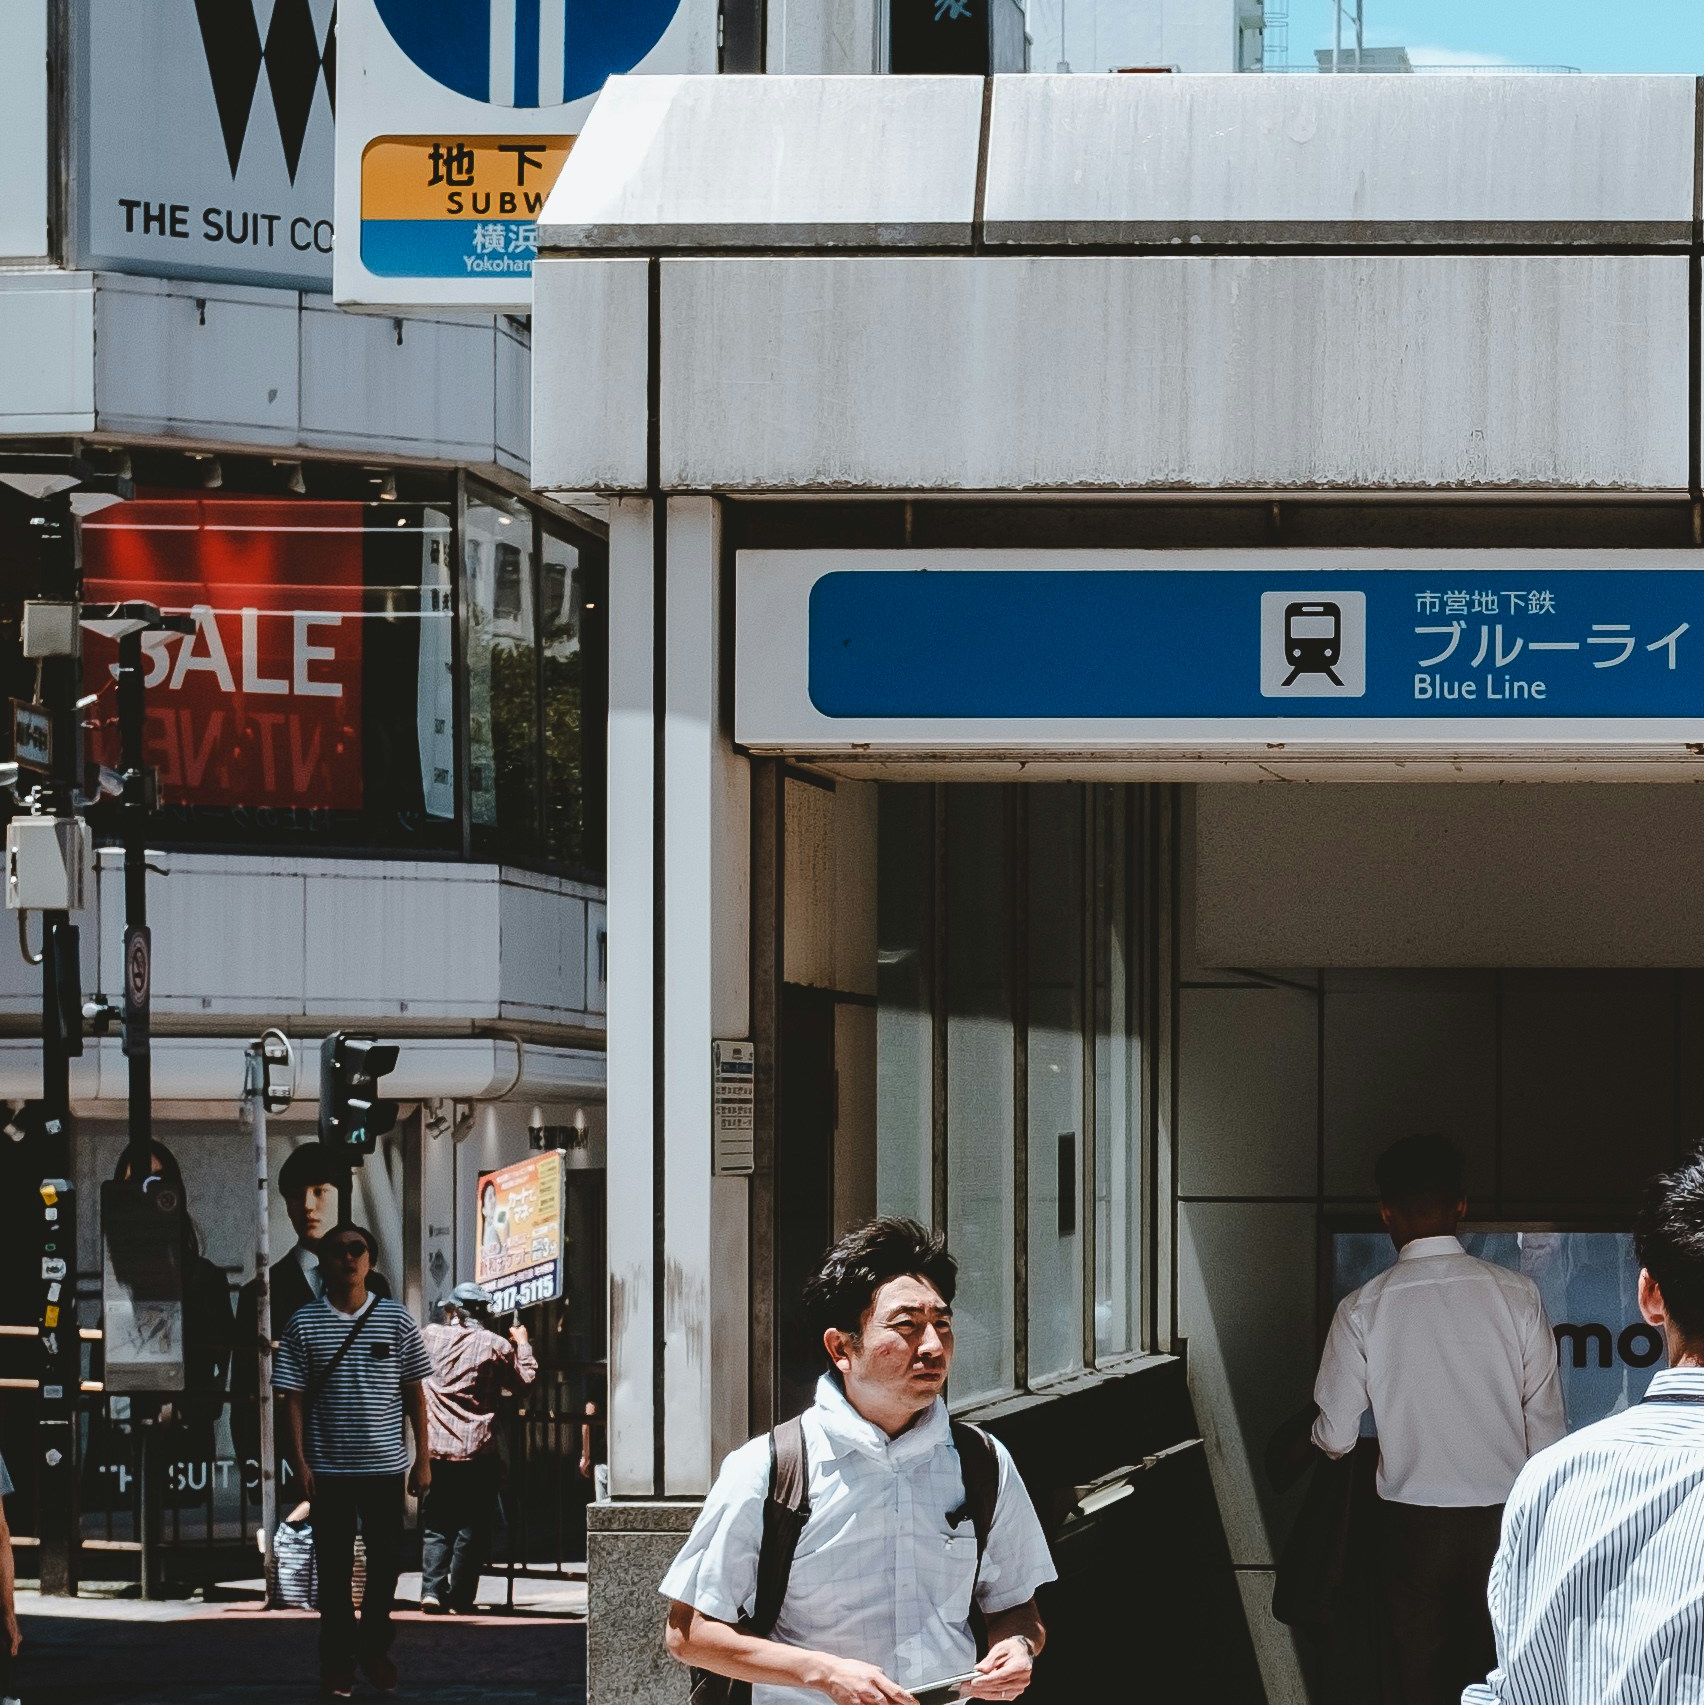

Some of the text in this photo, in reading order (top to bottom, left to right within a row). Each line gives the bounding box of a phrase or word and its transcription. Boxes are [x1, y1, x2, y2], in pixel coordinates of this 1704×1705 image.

[118, 198, 191, 239] THE
[201, 208, 282, 247] SUIT
[472, 223, 538, 254] 横浜
[1415, 589, 1556, 616] 市営地下鉄
[1414, 674, 1547, 700] Blue Line
